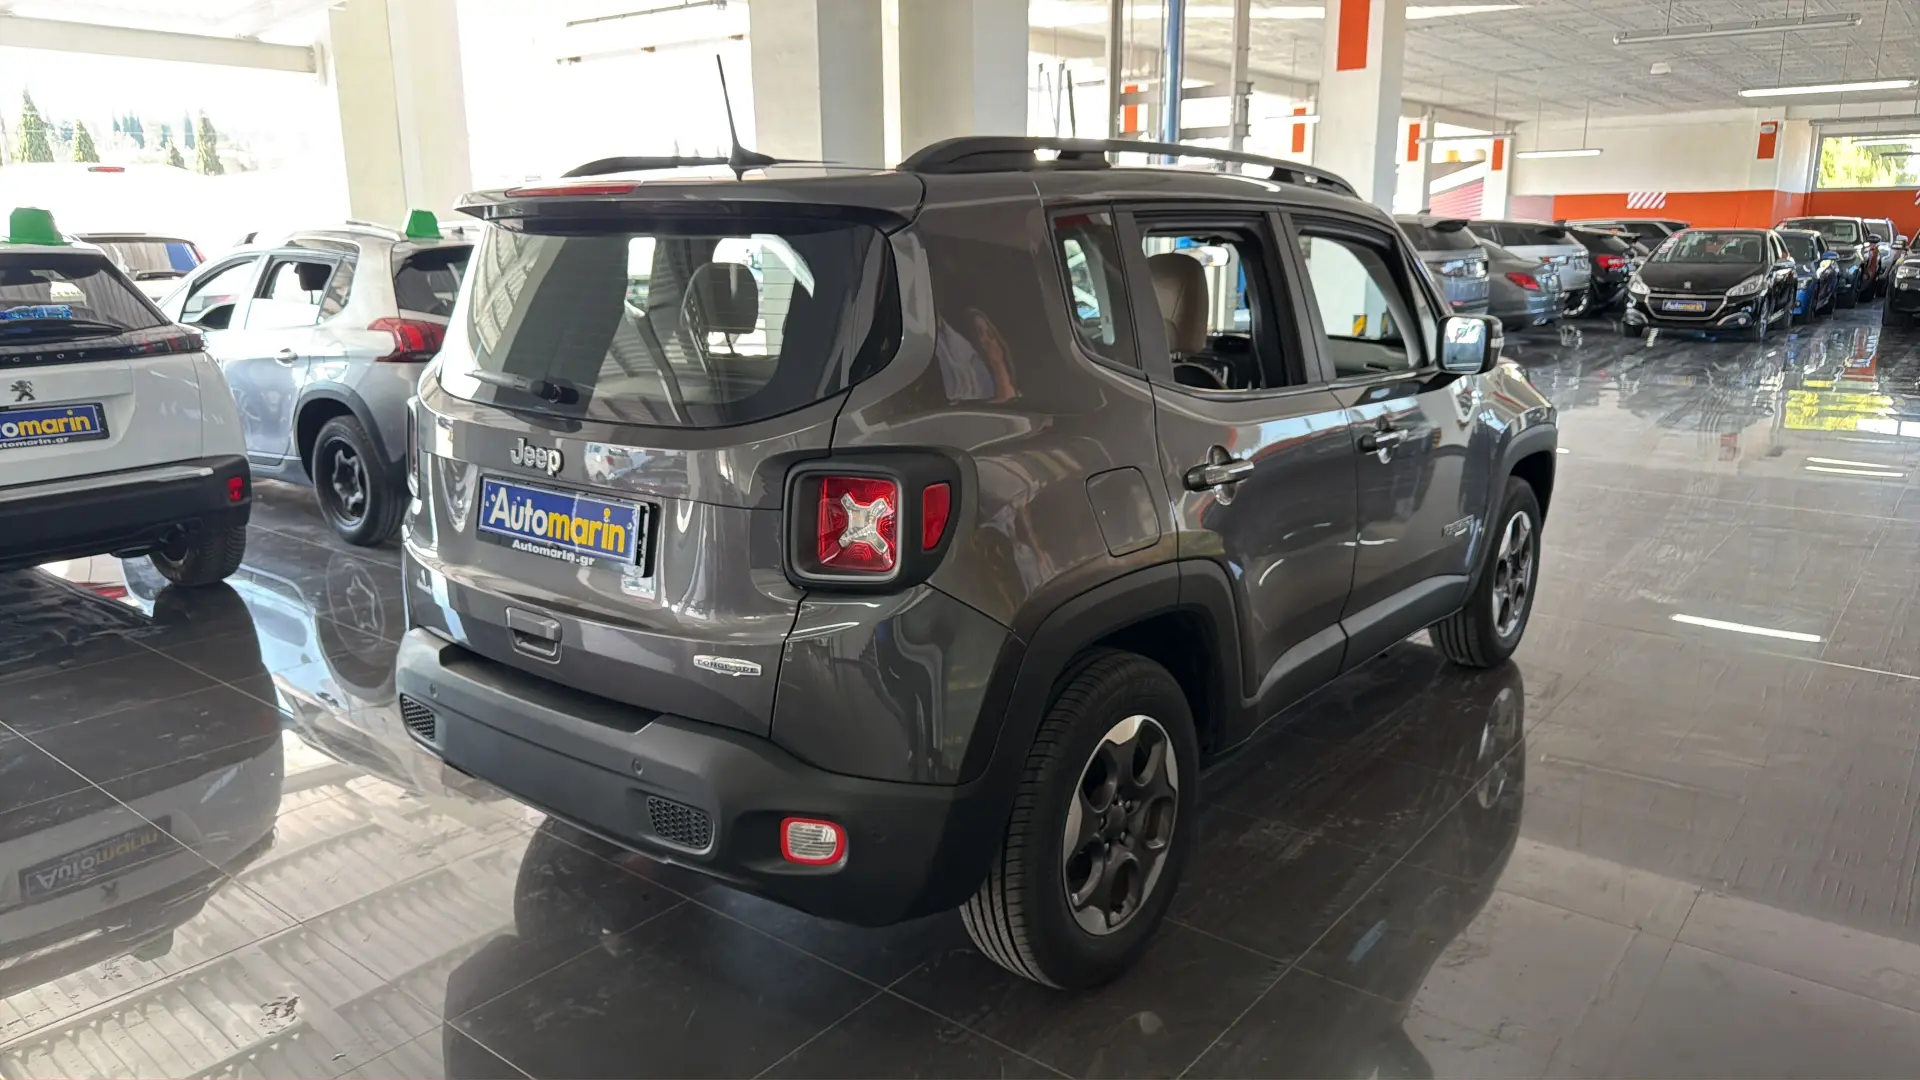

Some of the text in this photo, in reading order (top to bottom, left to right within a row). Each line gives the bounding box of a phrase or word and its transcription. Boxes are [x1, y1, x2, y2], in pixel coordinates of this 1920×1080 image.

[0, 410, 91, 437] omarin
[510, 437, 562, 476] Jeep
[489, 487, 625, 553] Automarin
[512, 539, 595, 565] Automarin.gr
[697, 659, 759, 674] LONGIUDE
